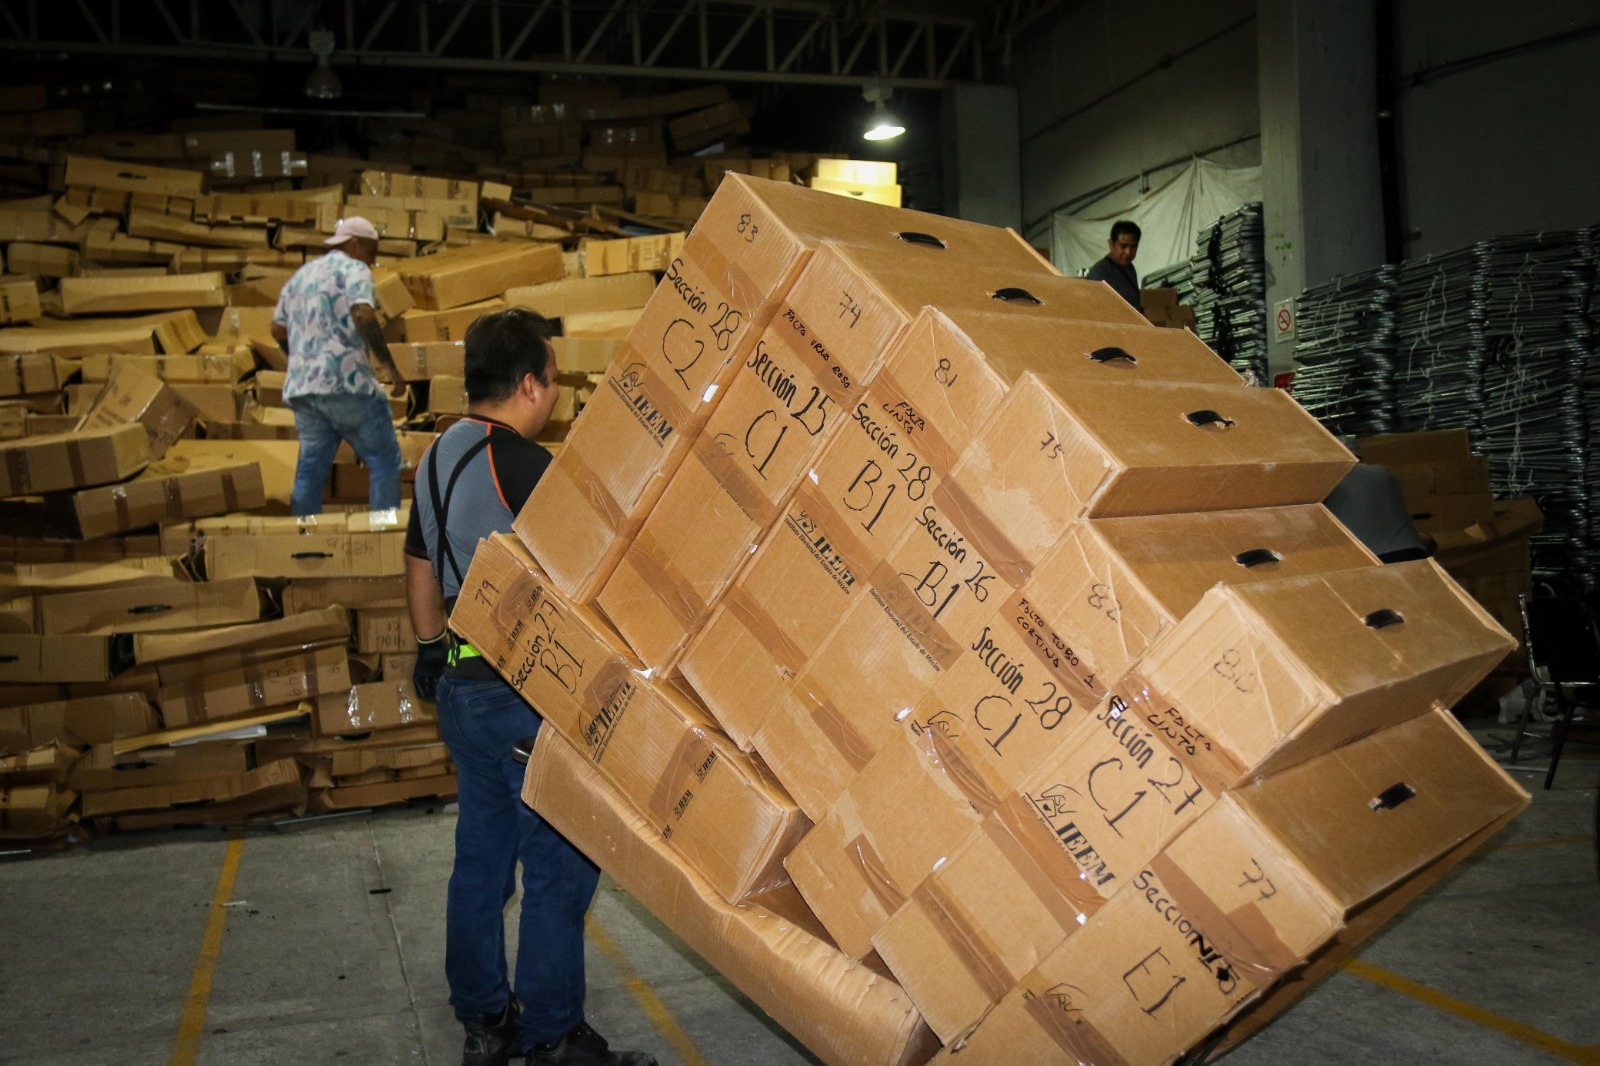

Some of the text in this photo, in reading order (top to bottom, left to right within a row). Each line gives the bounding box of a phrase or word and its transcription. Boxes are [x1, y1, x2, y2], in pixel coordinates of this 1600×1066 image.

[737, 213, 759, 243] 83
[666, 257, 742, 351] Sección 28
[839, 290, 862, 329] 74
[663, 318, 705, 390] C2
[934, 358, 958, 387] 81
[633, 394, 674, 441] IEEM
[747, 340, 836, 436] Sección 25
[745, 409, 788, 481] C1
[852, 402, 932, 501] Sección 28
[843, 459, 896, 537] B1
[799, 534, 816, 555] Electoral
[915, 505, 968, 565] Sección
[964, 561, 996, 603] 26
[475, 578, 500, 608] 79
[914, 560, 960, 621] B1
[511, 599, 566, 691] Sección 27
[869, 588, 886, 608] Instituto
[884, 606, 903, 628] Electoral
[900, 625, 909, 635] del
[906, 632, 921, 650] Estado
[926, 654, 941, 672] México
[1051, 632, 1079, 667] TUBO
[540, 640, 586, 695] B1
[972, 626, 1073, 730] Sección 28
[974, 695, 1022, 757] C1
[1088, 757, 1147, 838] C1
[1147, 756, 1203, 816] 27
[1055, 821, 1116, 887] IEEM
[1238, 858, 1278, 901] 77
[1123, 946, 1186, 1020] E1
